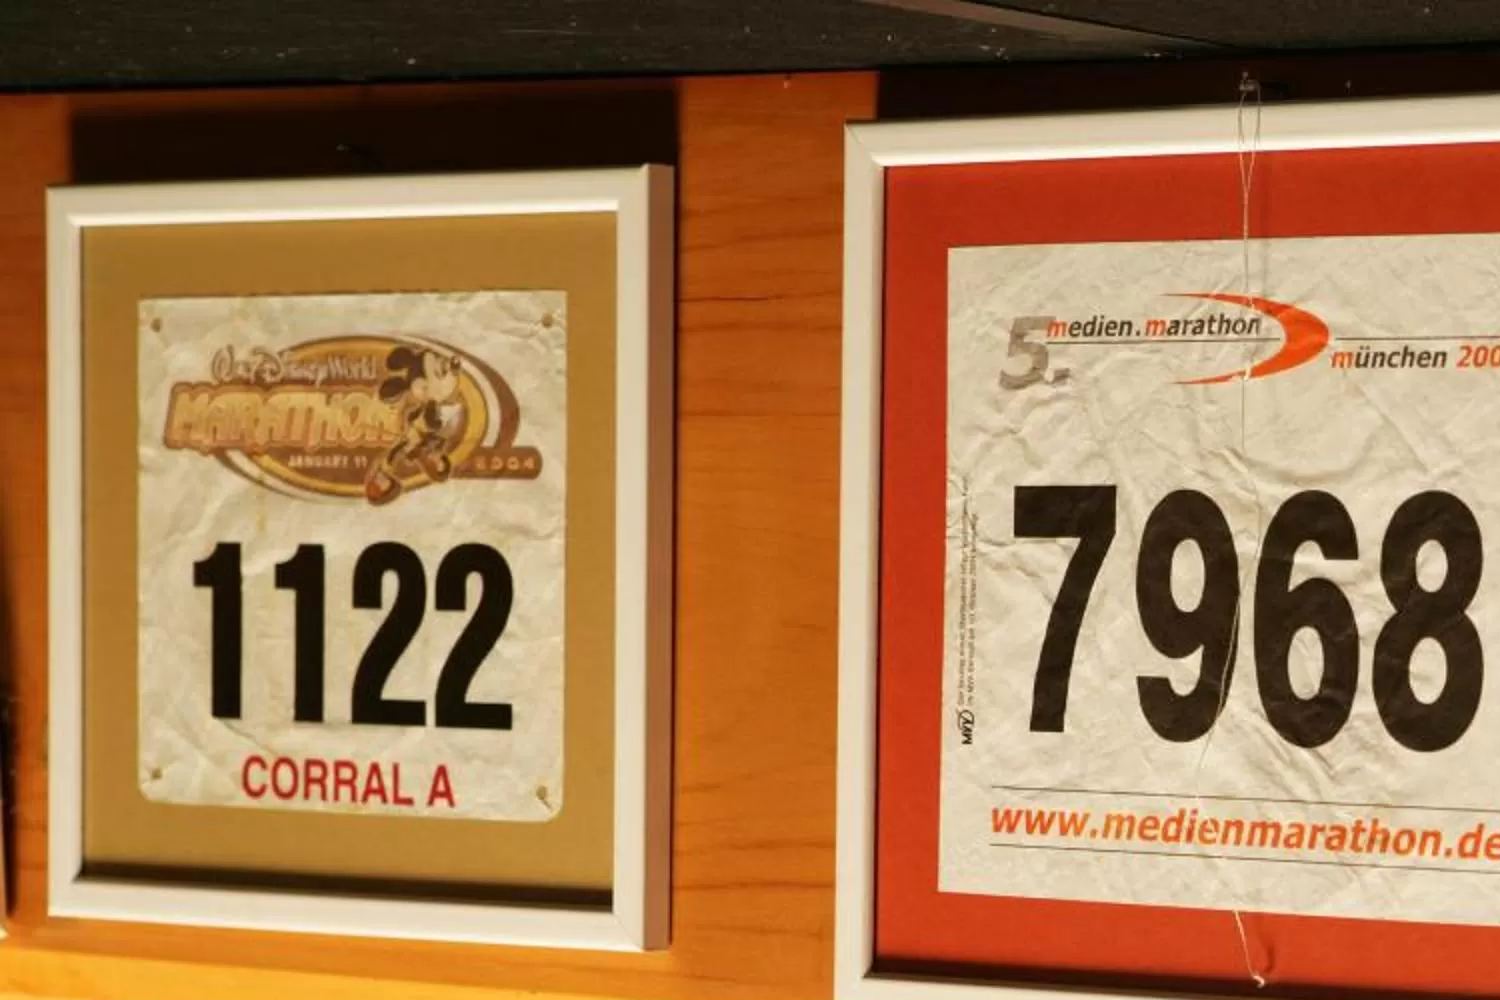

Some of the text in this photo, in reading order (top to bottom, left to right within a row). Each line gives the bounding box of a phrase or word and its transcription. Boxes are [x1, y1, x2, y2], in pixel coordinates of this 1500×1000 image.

[328, 354, 377, 380] World
[1331, 344, 1447, 370] münchen
[193, 541, 514, 731] 1122
[1013, 484, 1485, 753] 7968
[241, 755, 456, 808] CORRAL A
